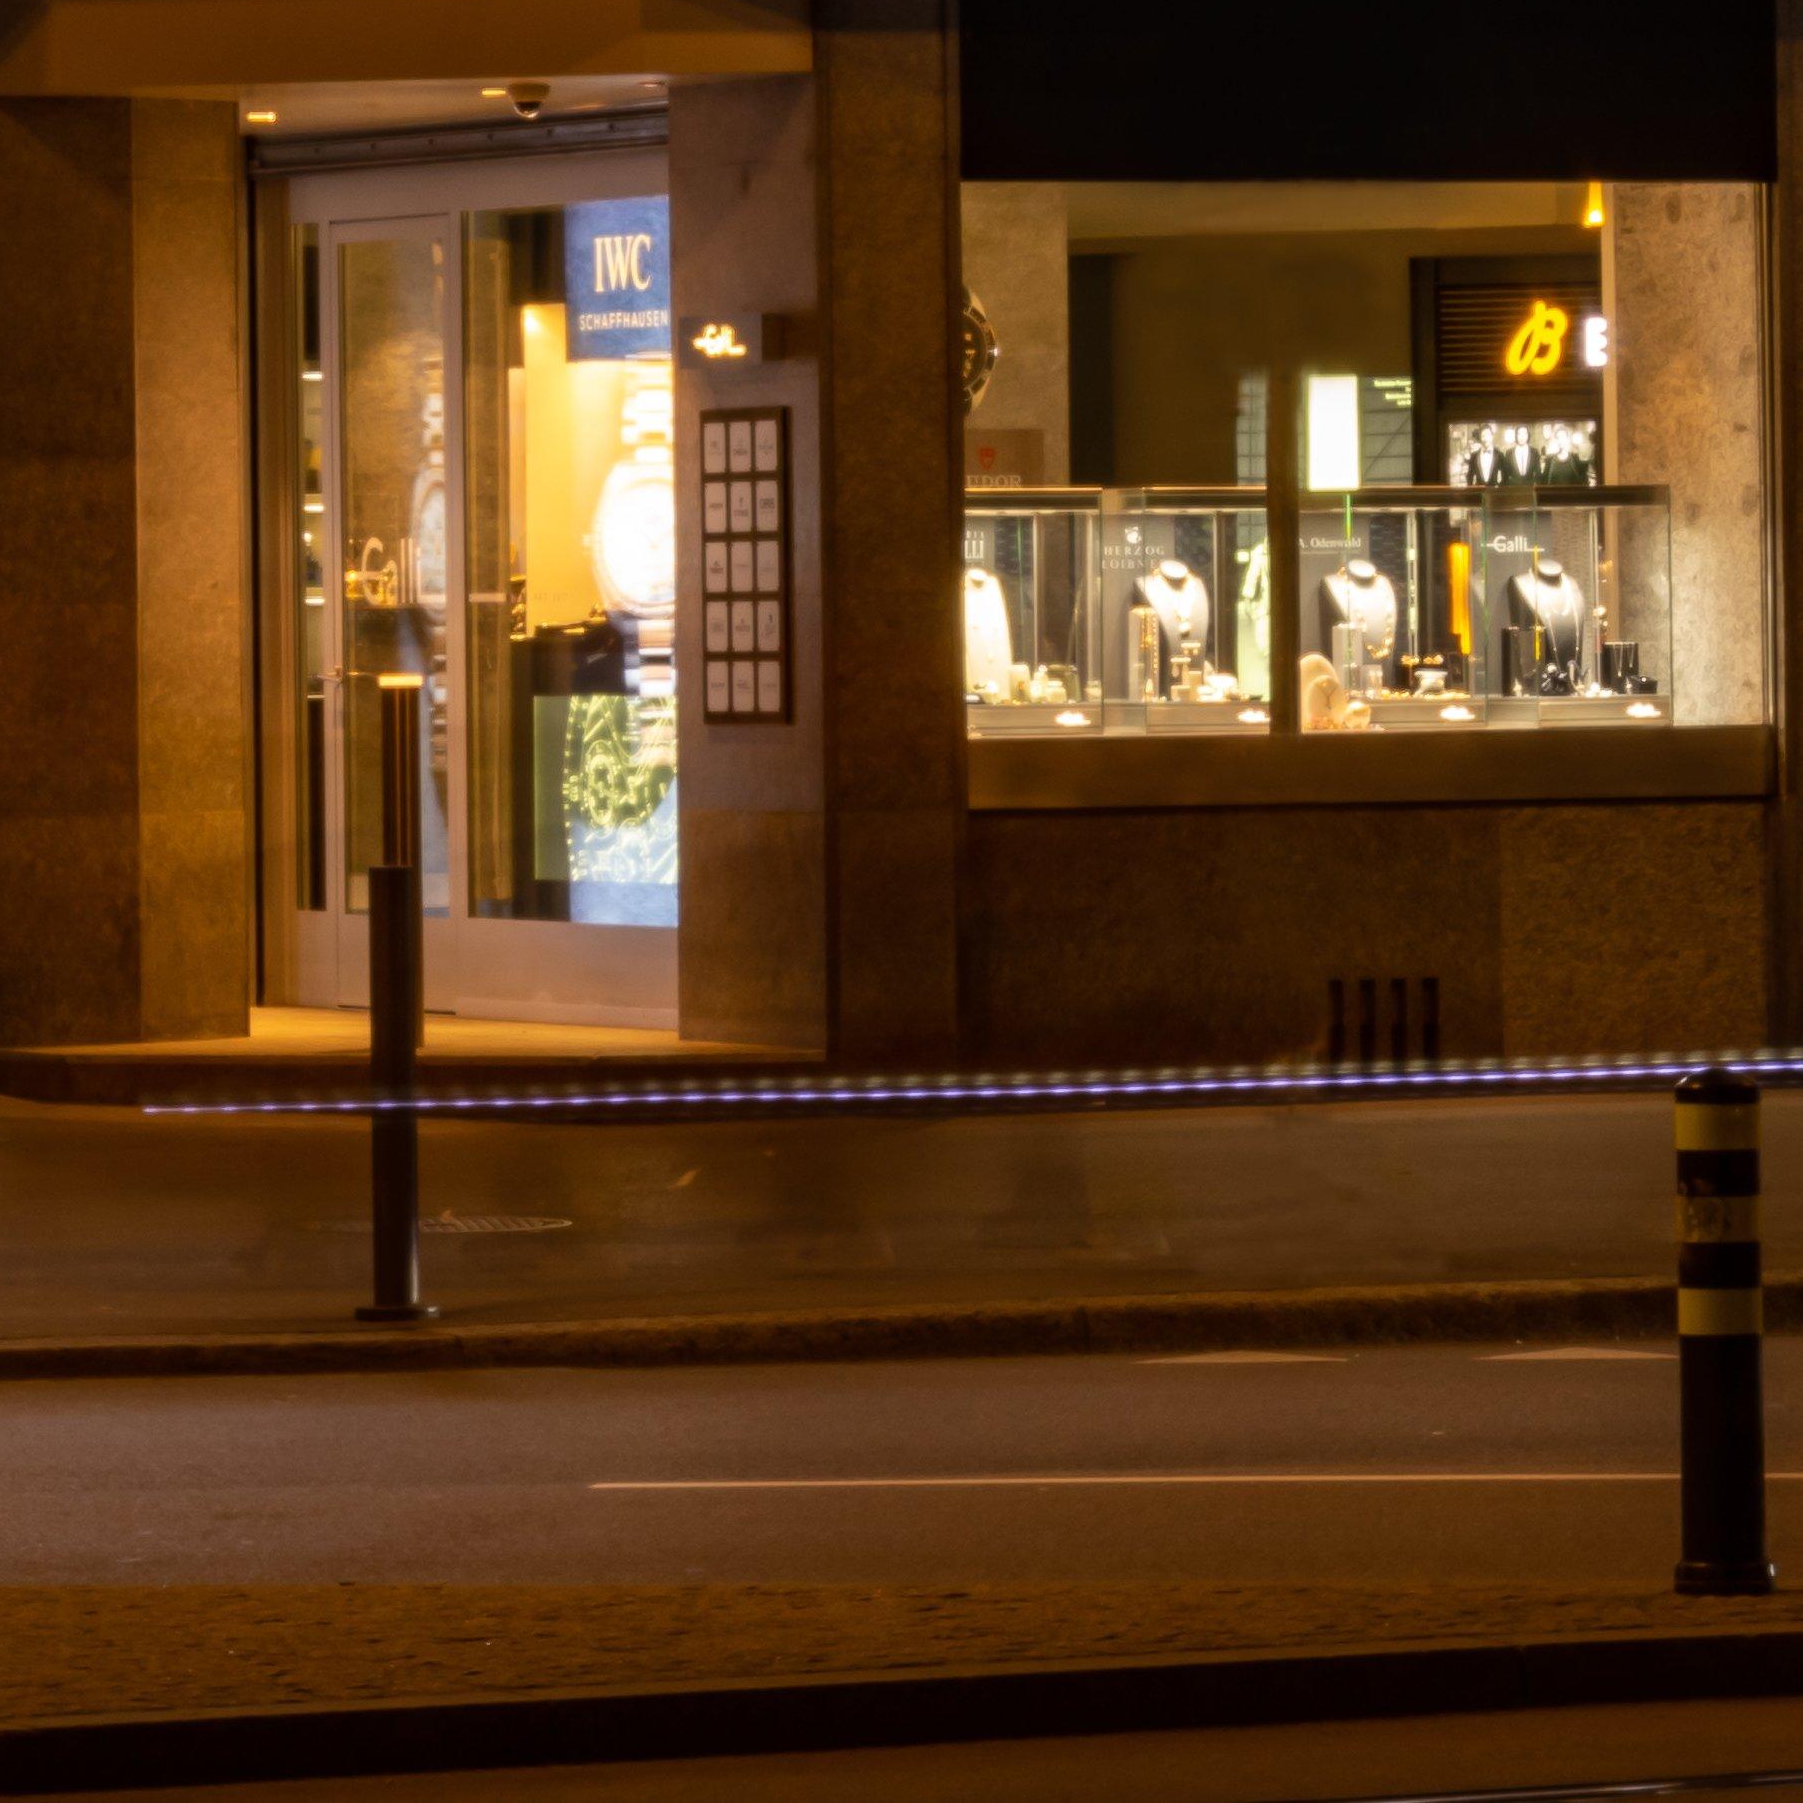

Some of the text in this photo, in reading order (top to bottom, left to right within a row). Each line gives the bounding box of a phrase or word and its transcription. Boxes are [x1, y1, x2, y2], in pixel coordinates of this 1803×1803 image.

[594, 233, 652, 293] IWC
[579, 309, 670, 332] SCHAFFHAUSEN
[1485, 534, 1545, 553] Galli
